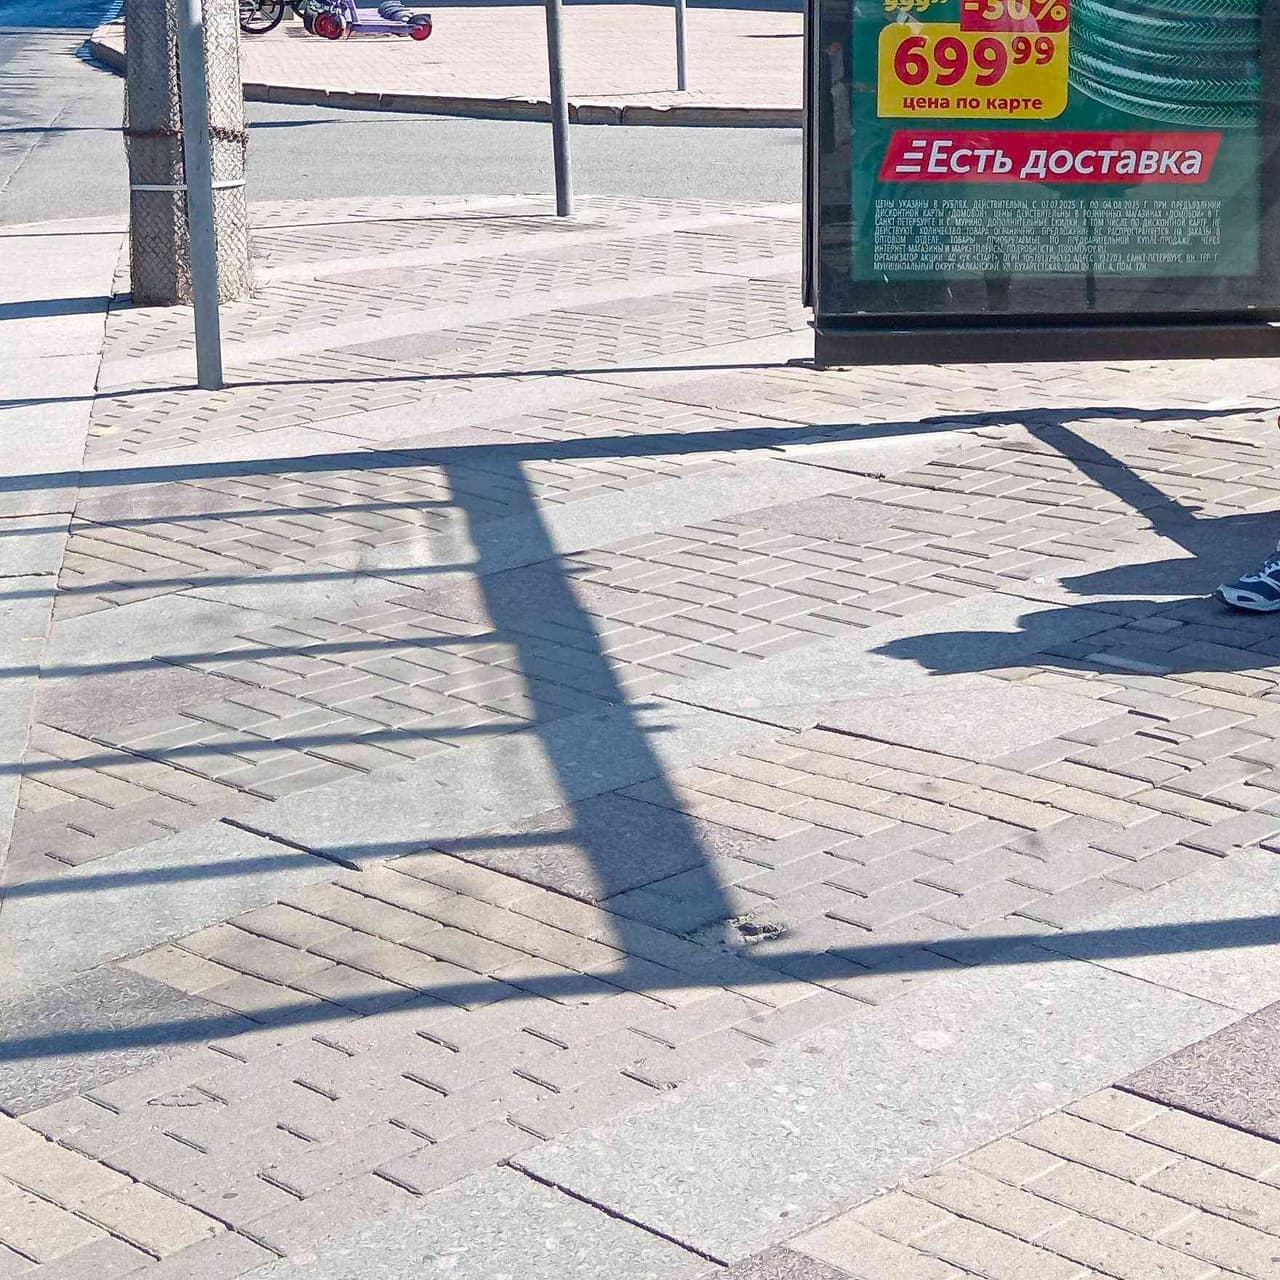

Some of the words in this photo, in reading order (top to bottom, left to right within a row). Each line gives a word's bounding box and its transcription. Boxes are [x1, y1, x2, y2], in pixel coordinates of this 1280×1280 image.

[902, 96, 951, 111] цена
[956, 96, 981, 110] по
[986, 97, 1043, 114] карте
[927, 139, 1014, 174] Есть
[1020, 149, 1203, 180] доставка
